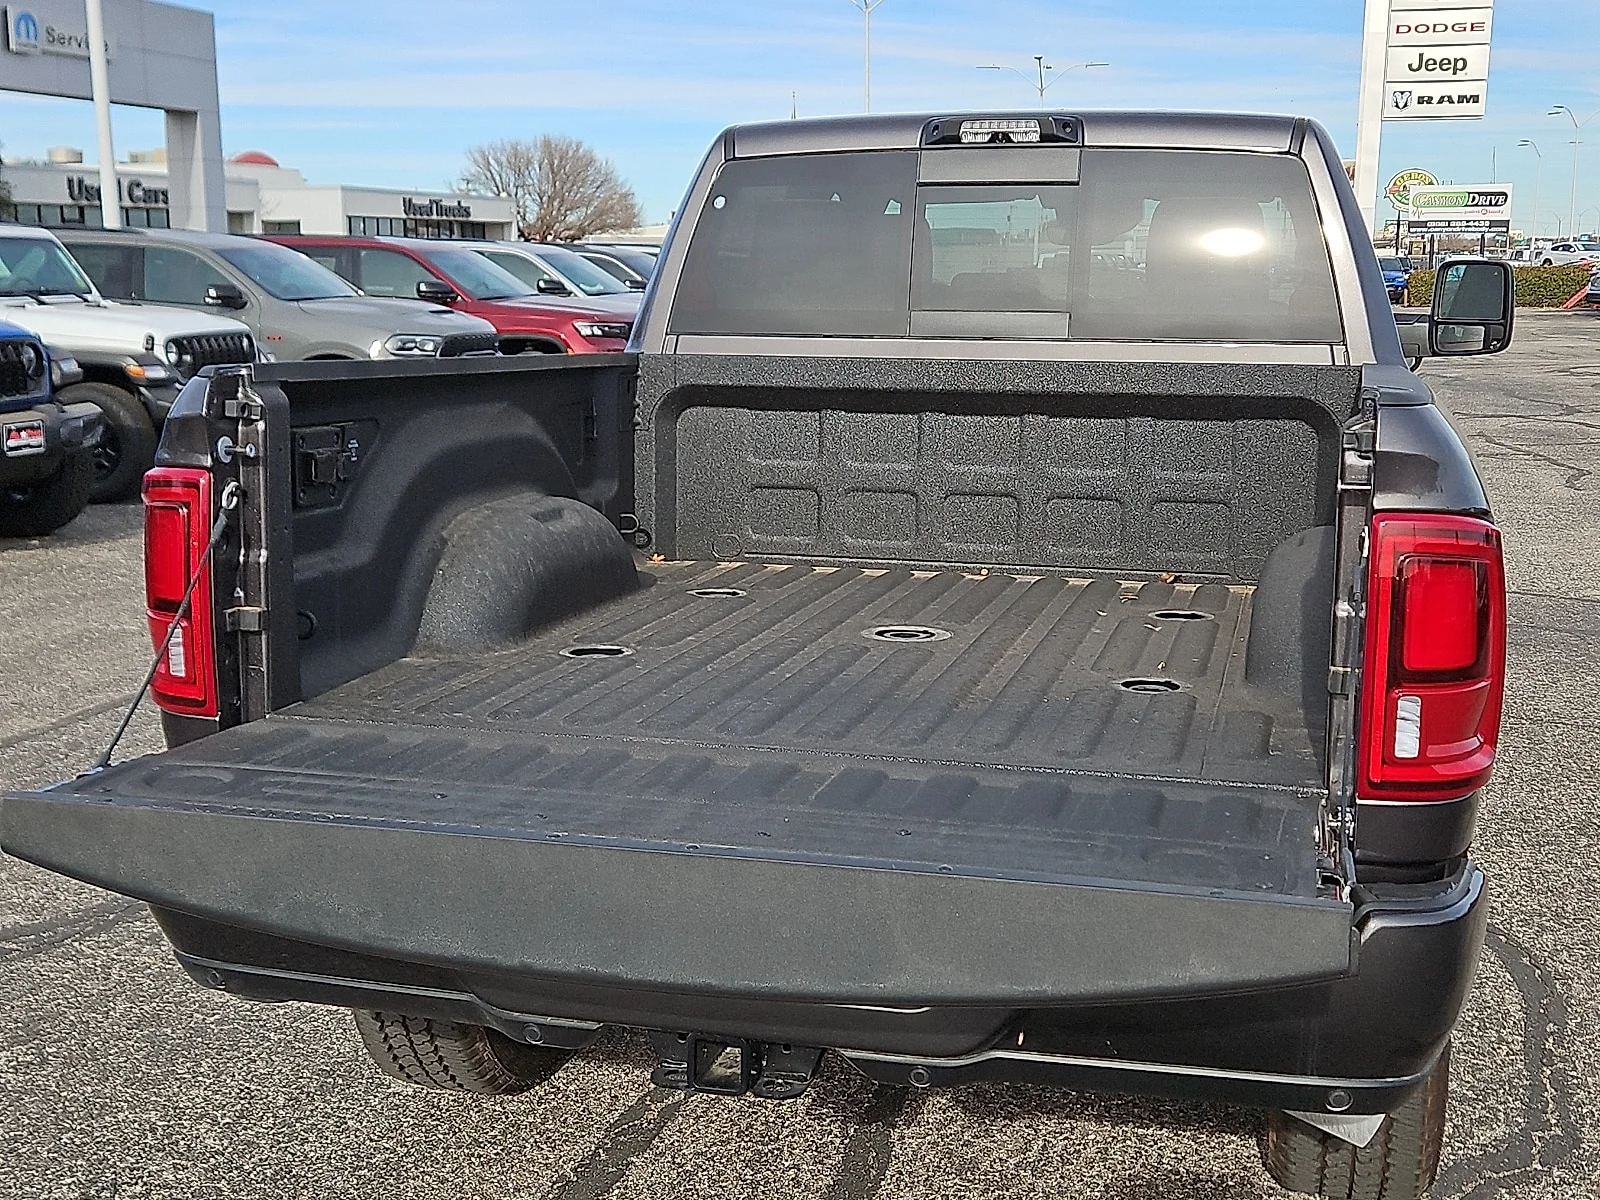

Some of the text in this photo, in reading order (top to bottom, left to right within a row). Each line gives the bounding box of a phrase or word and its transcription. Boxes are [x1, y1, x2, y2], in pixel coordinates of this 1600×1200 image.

[45, 25, 109, 52] Servi
[1395, 22, 1486, 34] DODGE
[1408, 52, 1468, 75] Jeep
[1416, 94, 1480, 105] RAM
[66, 176, 169, 205] Us Cars
[402, 196, 471, 218] Used Trucks
